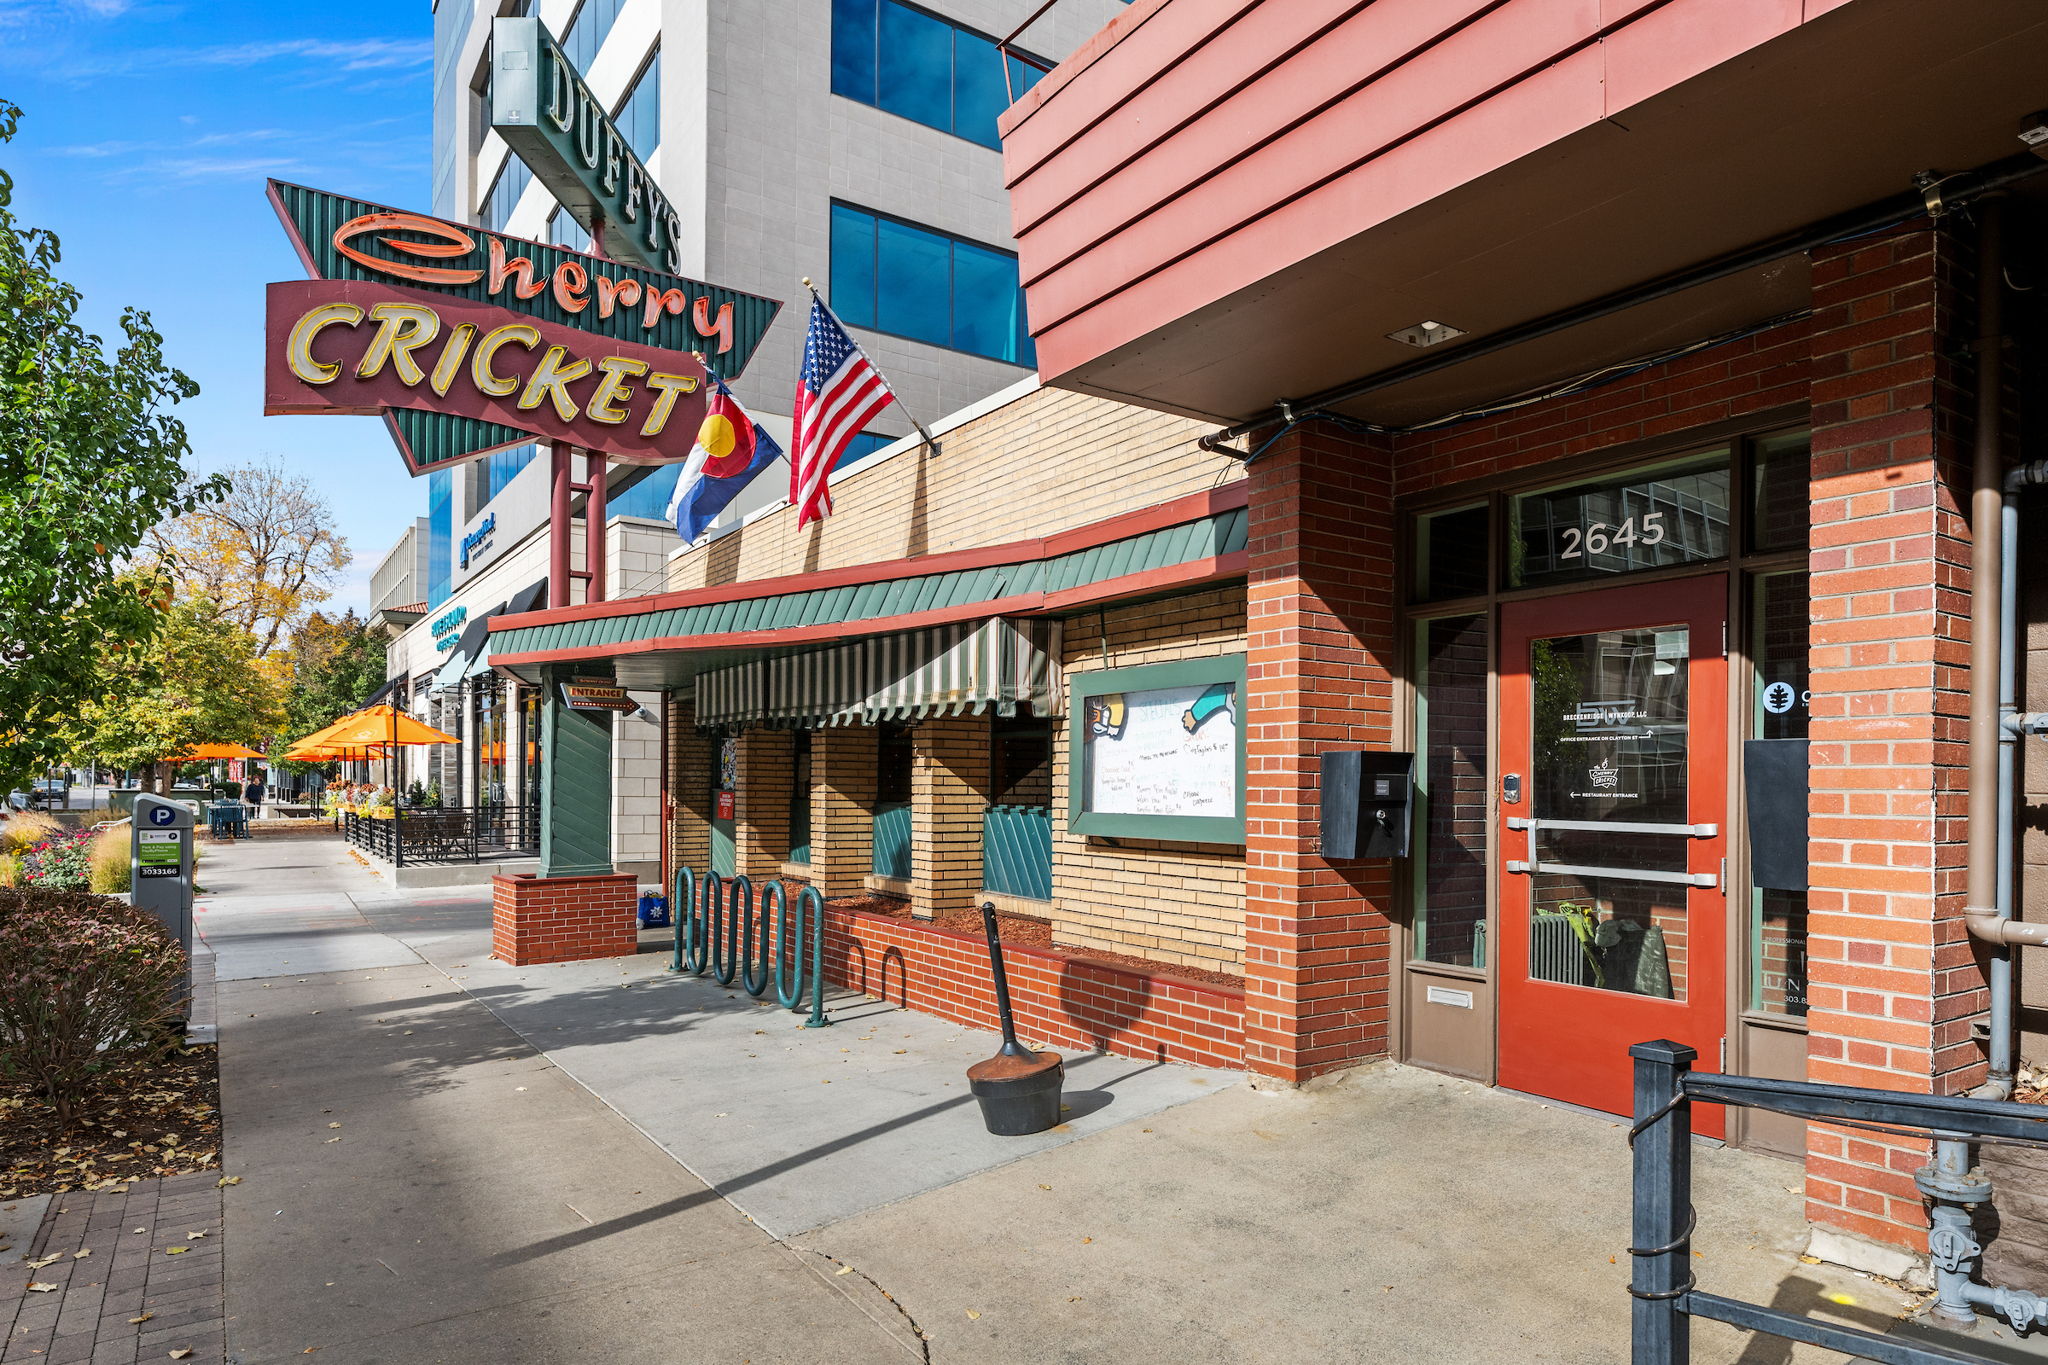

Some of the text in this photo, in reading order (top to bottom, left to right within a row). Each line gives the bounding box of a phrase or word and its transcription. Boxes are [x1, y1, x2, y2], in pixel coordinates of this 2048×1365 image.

[549, 42, 681, 276] DUFFY'S
[332, 213, 735, 354] Cherry
[286, 302, 700, 437] CRICKET
[1561, 511, 1665, 559] 2645
[571, 687, 621, 697] ENTRANCE
[1608, 711, 1635, 719] WYNKOOP,
[156, 809, 170, 822] P
[1783, 995, 1807, 1004] 303.8
